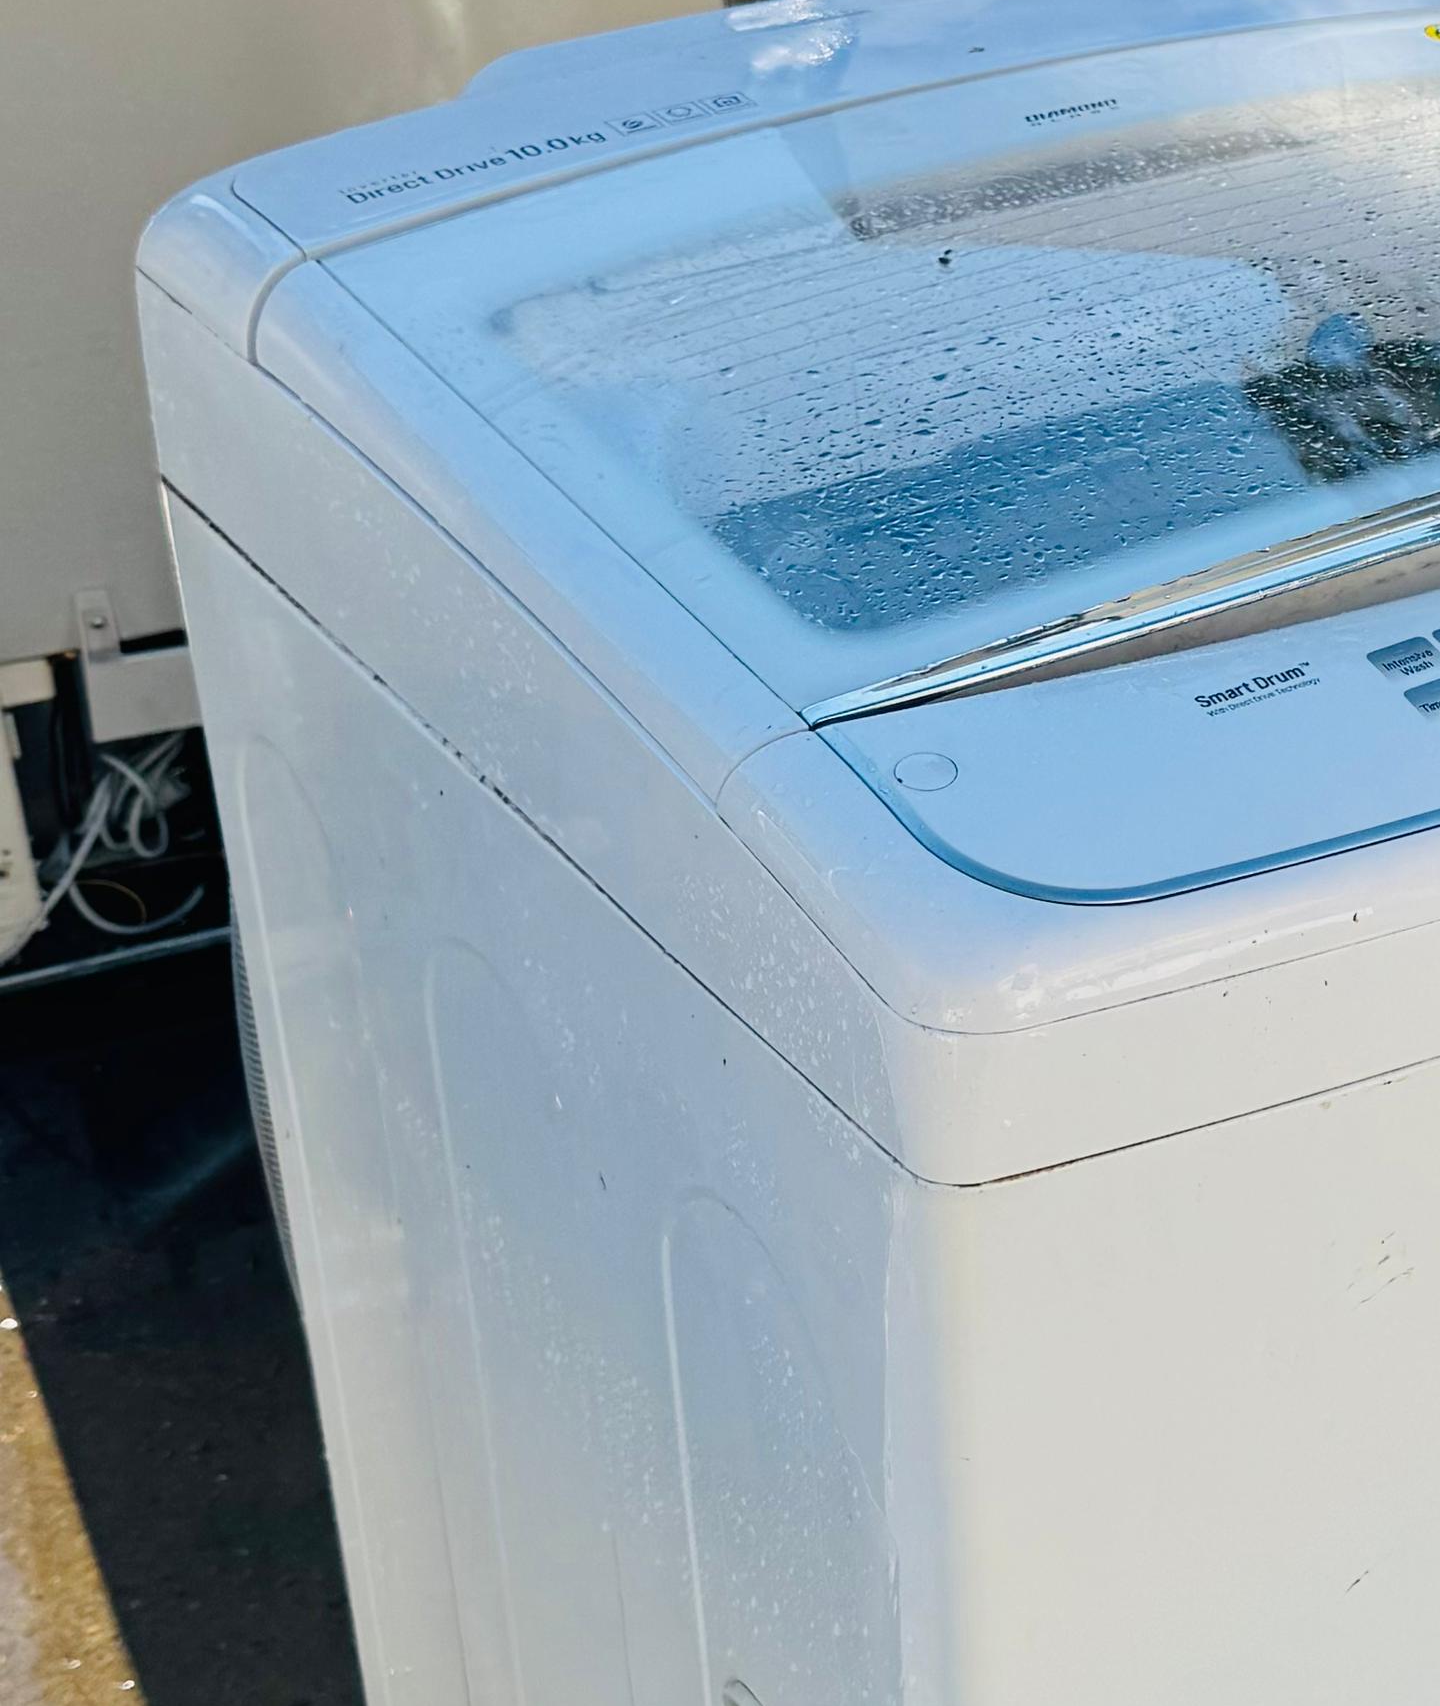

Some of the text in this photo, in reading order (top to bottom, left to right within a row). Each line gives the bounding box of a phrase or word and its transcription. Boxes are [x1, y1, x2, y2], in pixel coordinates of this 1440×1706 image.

[346, 177, 435, 205] Direct
[434, 156, 507, 181] Drive
[1400, 660, 1434, 676] Wash
[1194, 682, 1255, 708] Smart
